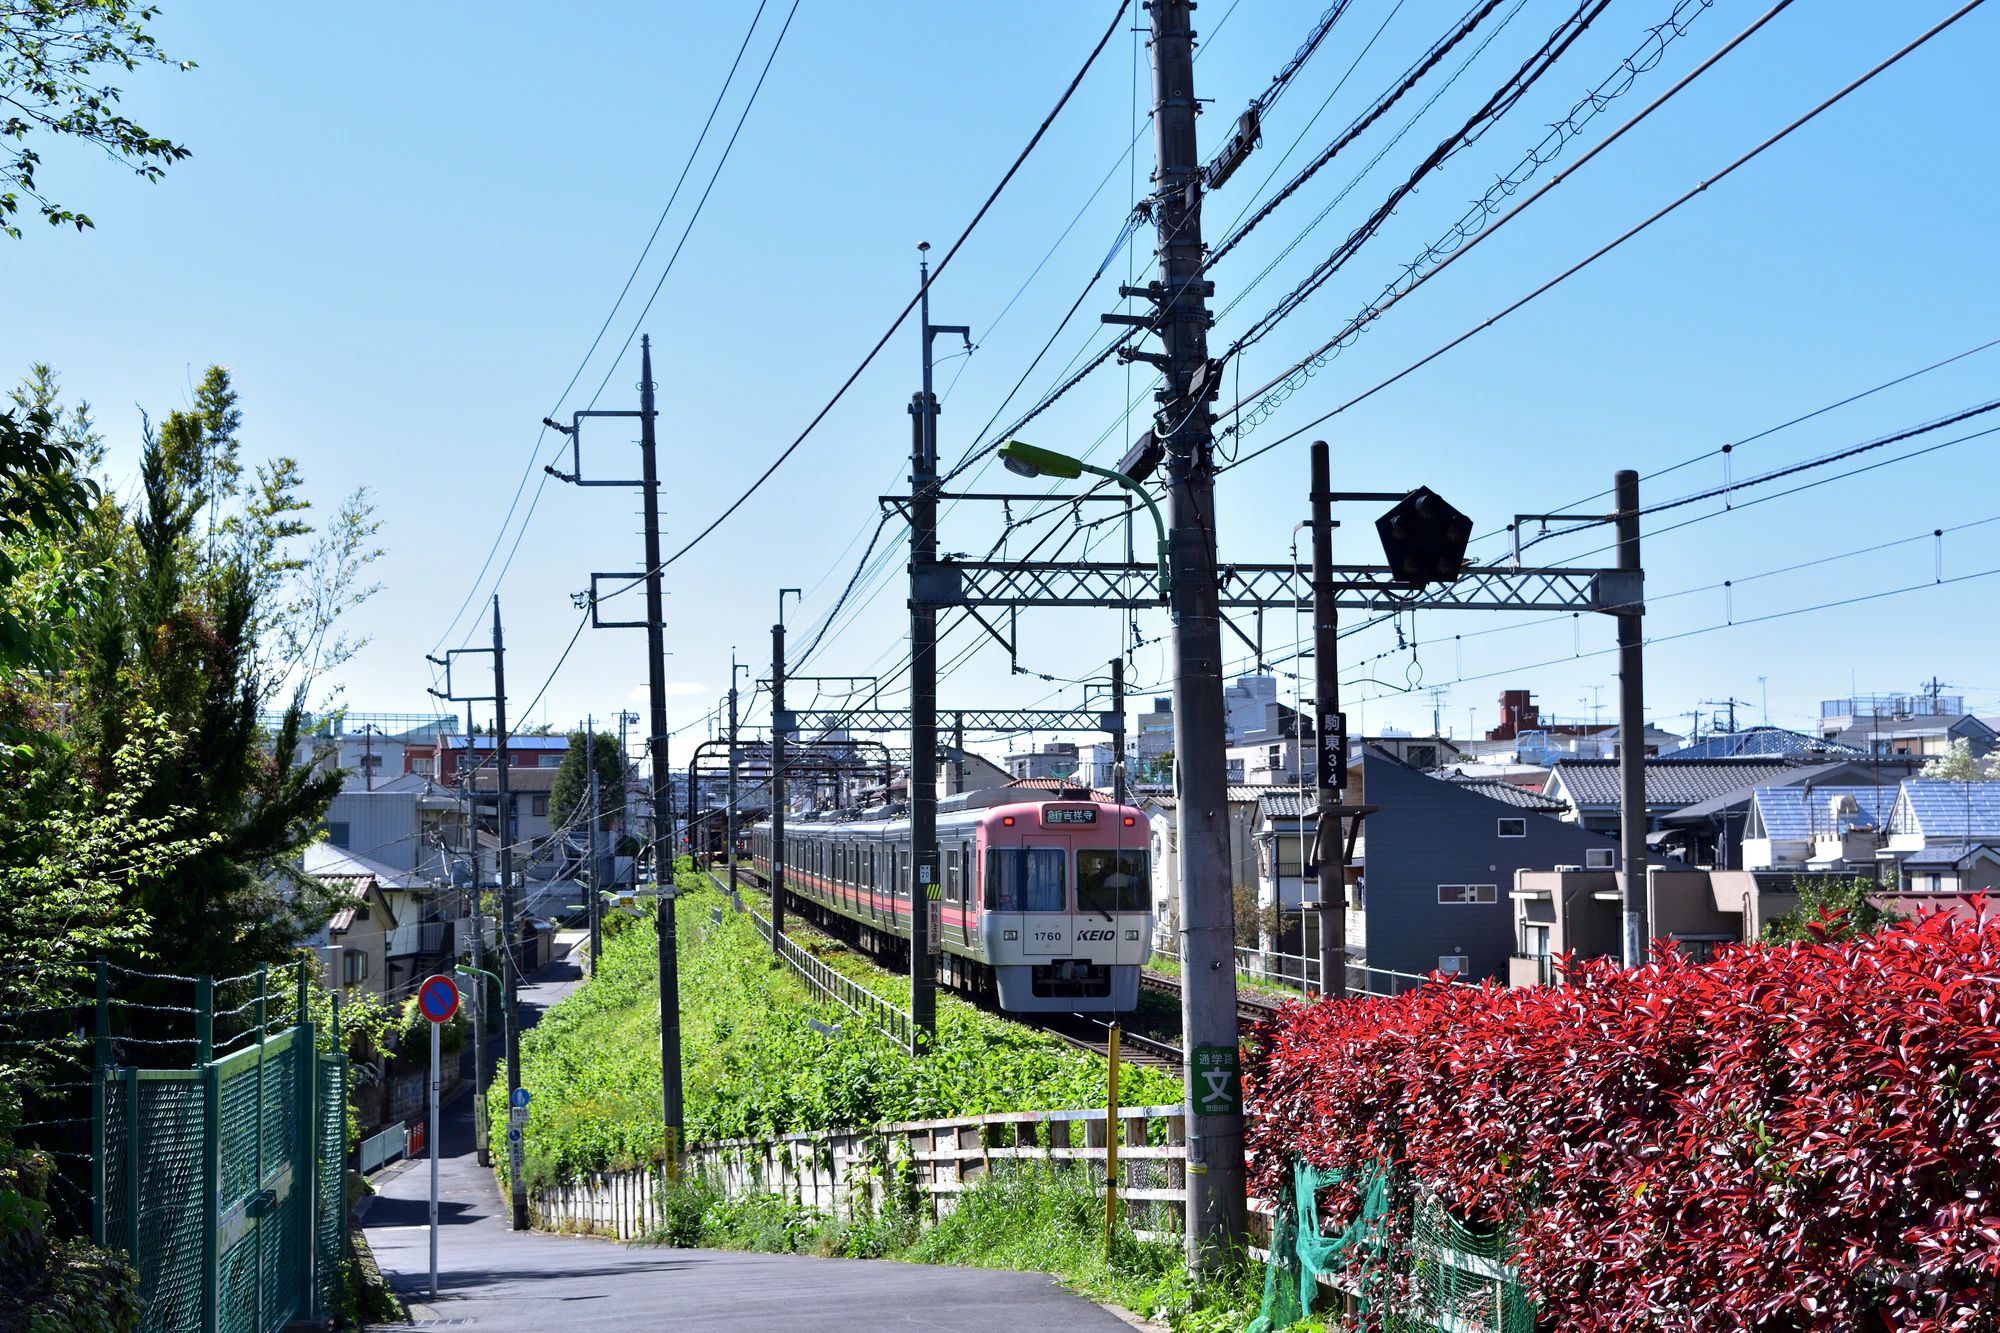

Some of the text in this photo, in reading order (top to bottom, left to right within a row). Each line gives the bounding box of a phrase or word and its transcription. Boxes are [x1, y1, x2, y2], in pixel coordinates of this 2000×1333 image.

[920, 871, 930, 879] 20
[930, 903, 938, 943] 制動注意
[1034, 932, 1062, 941] 1760
[1077, 930, 1115, 941] KEIO
[928, 945, 940, 953] 290
[1199, 1053, 1234, 1065] 通学路
[1201, 1066, 1233, 1103] 文
[1205, 1104, 1230, 1112] 世田谷区
